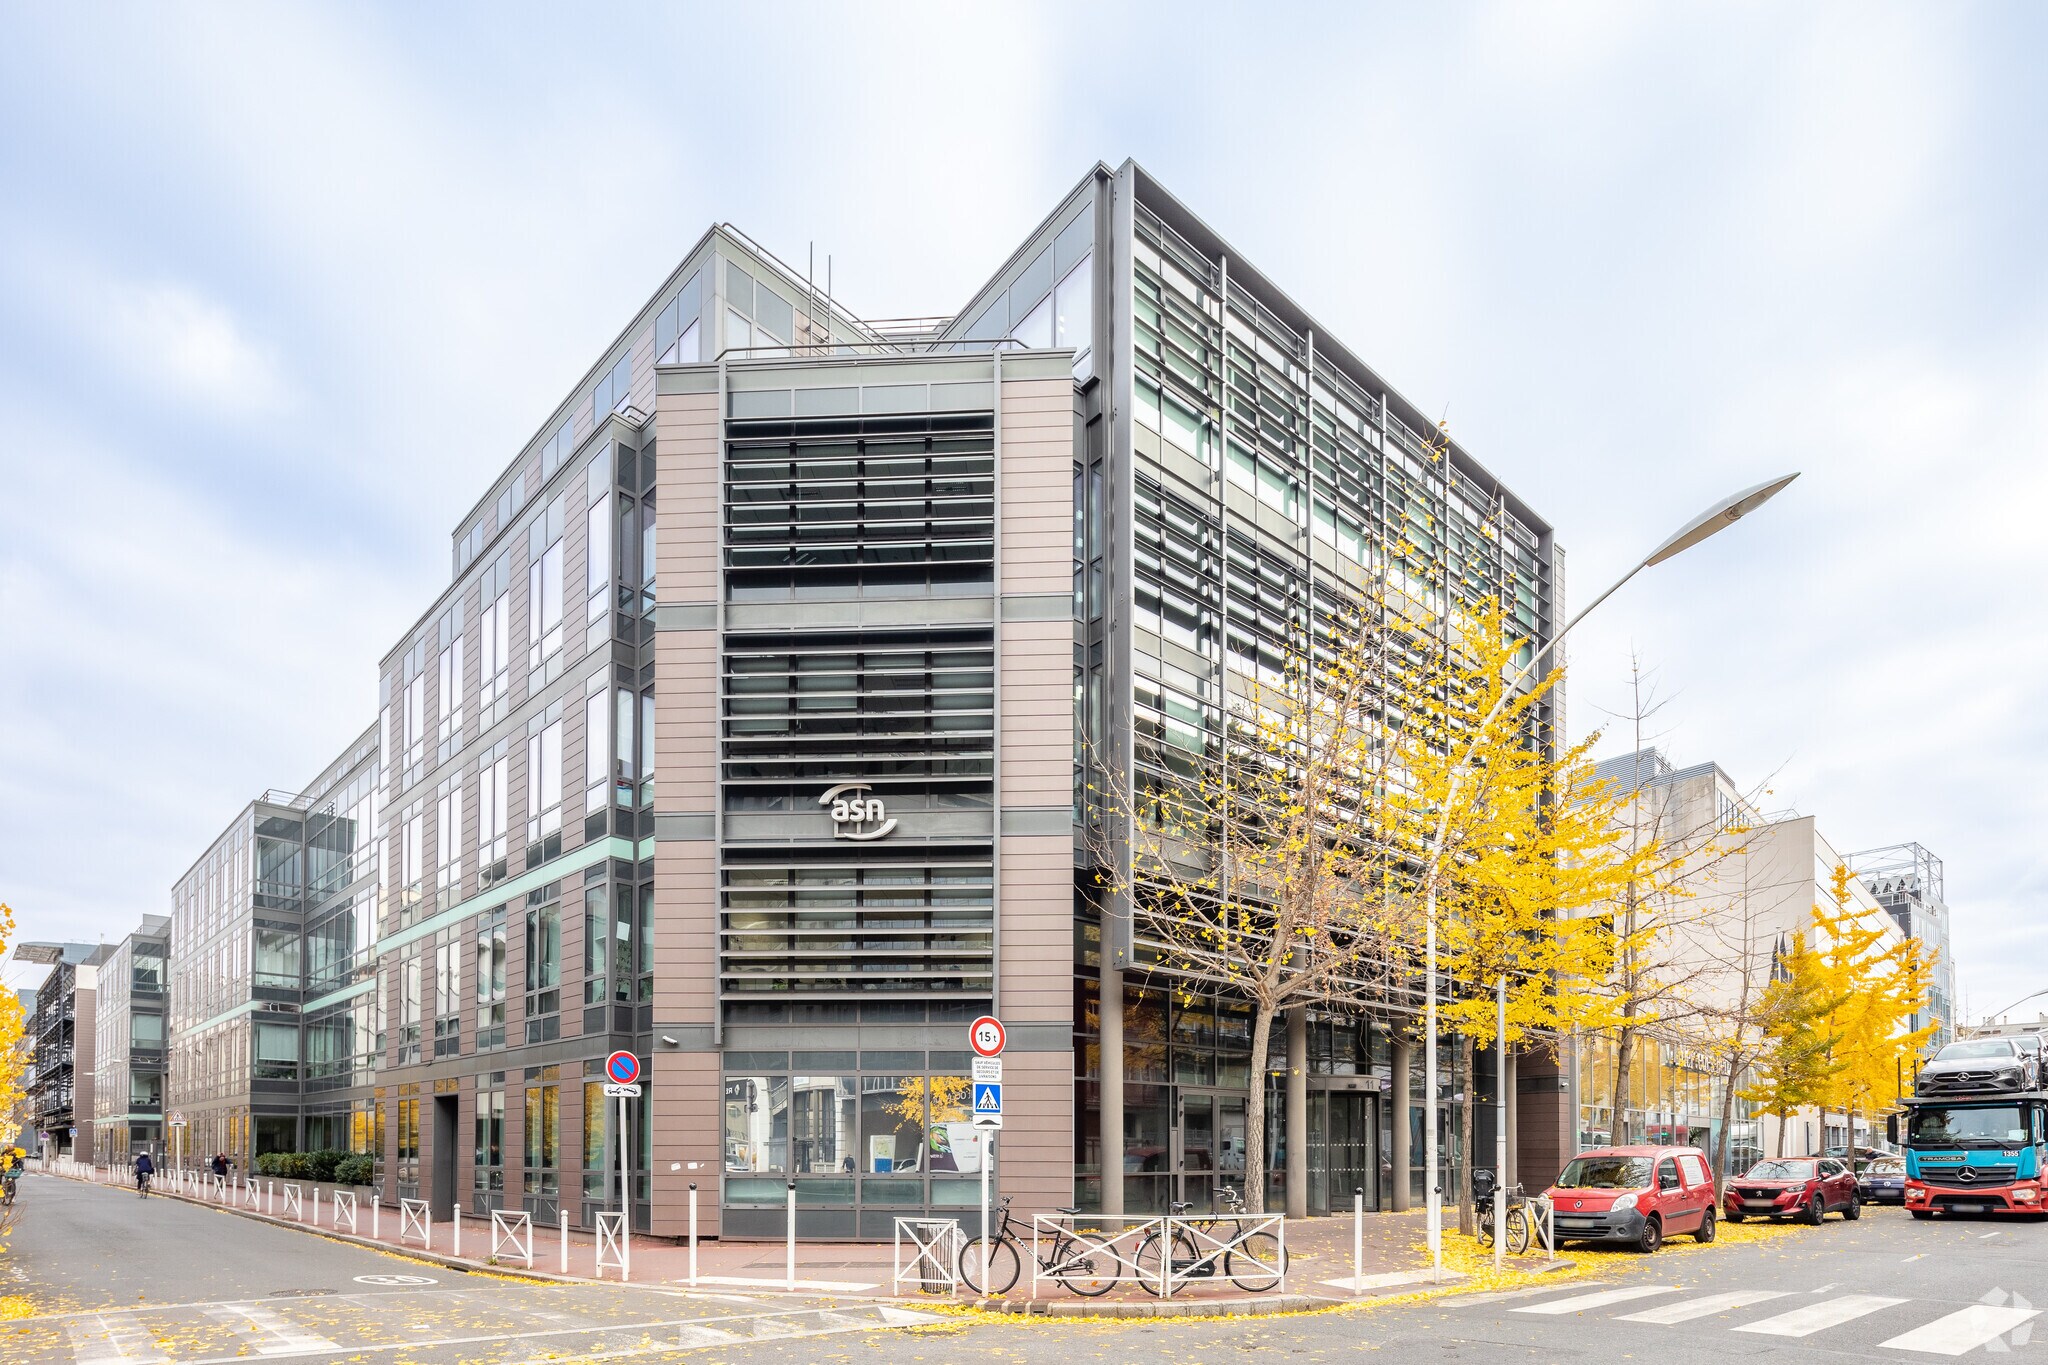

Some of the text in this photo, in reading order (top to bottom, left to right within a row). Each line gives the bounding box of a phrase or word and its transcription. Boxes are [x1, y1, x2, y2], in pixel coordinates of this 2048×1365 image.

[831, 799, 885, 822] asn
[978, 1031, 991, 1042] 15
[1366, 1080, 1373, 1089] 11
